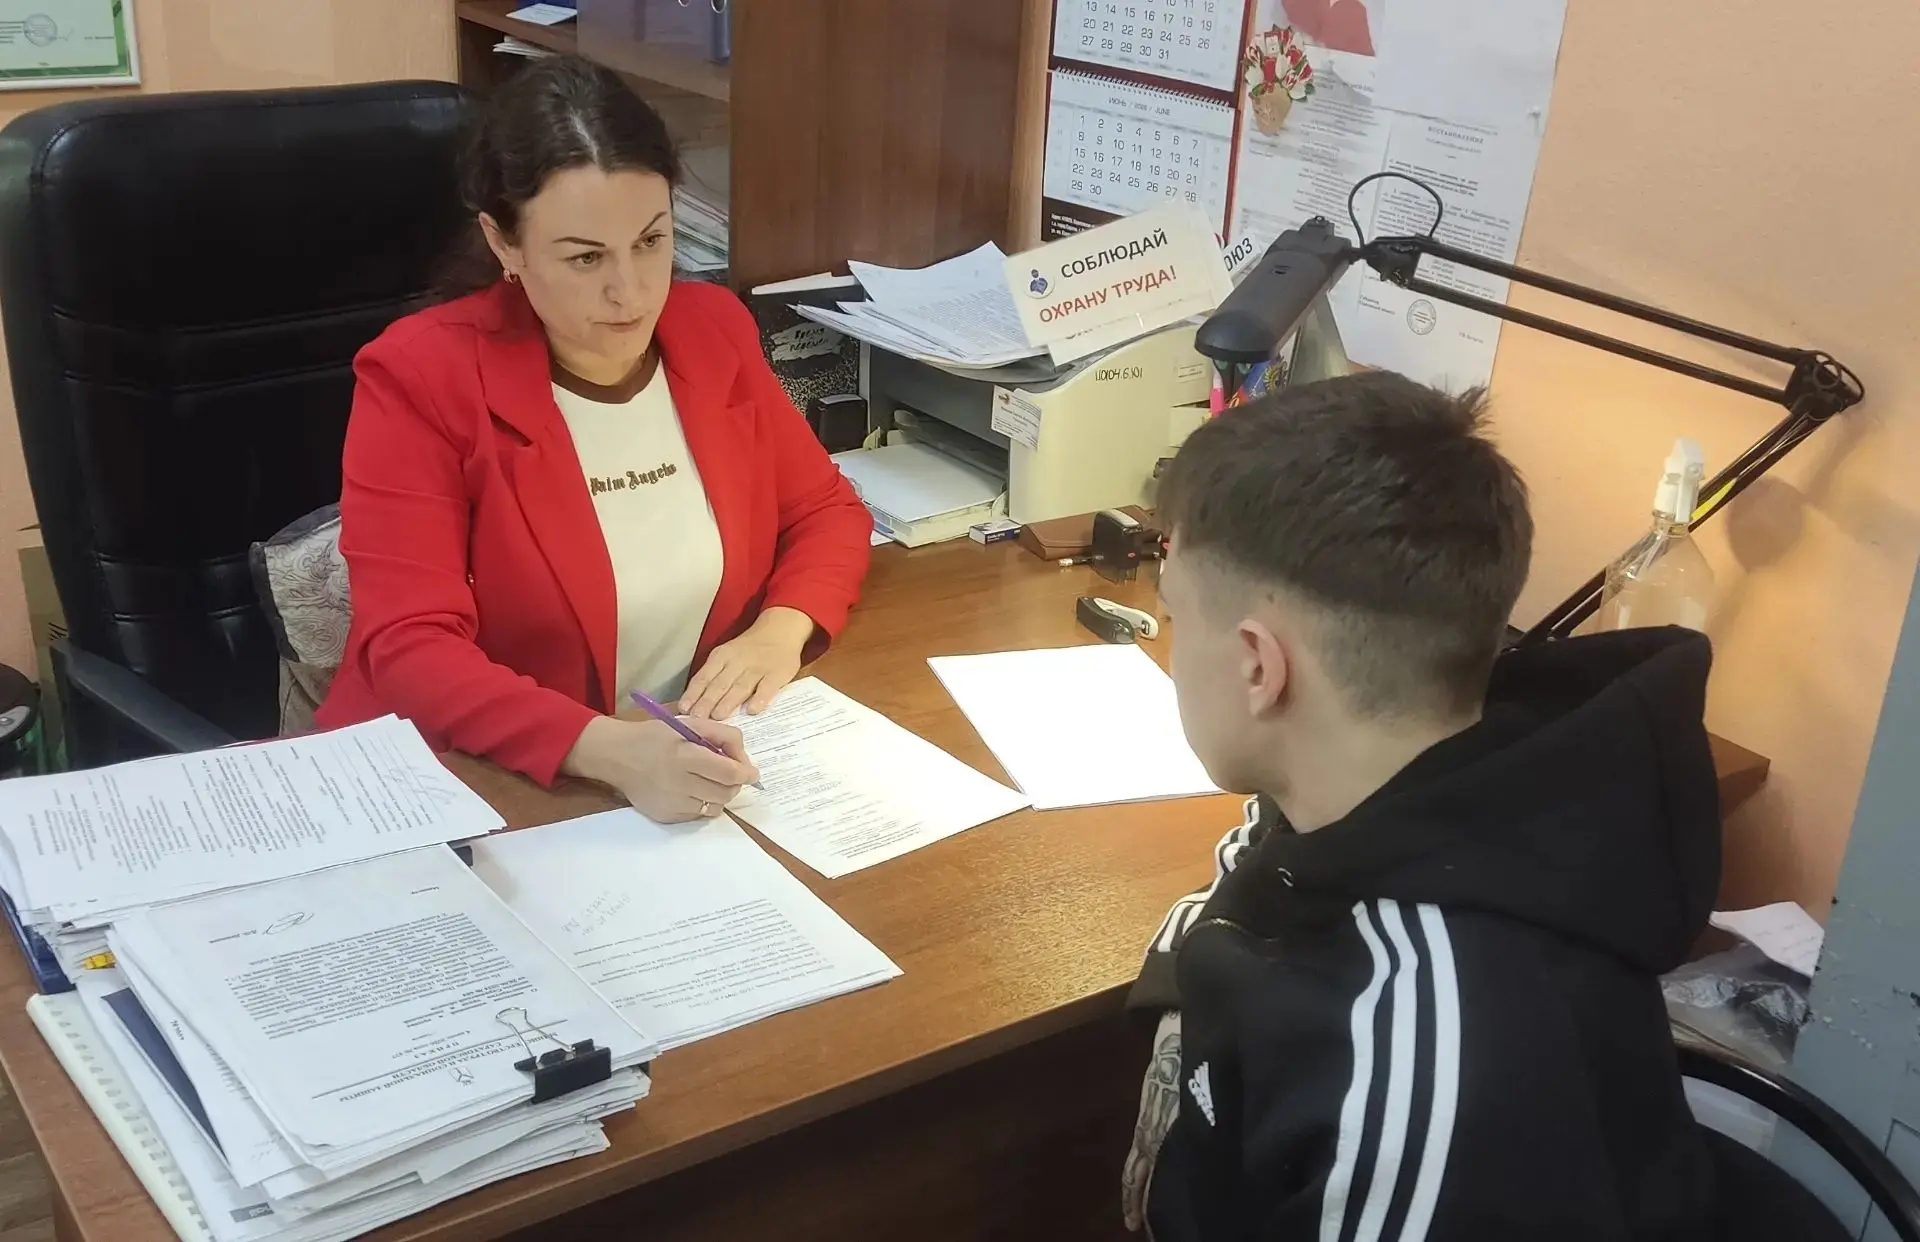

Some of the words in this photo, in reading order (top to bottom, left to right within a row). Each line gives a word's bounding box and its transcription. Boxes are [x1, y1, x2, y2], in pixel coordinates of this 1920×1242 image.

[1086, 1, 1097, 12] 13
[1105, 3, 1116, 15] 14
[1124, 7, 1135, 18] 15
[1144, 10, 1155, 21] 16
[1163, 13, 1174, 24] 17
[1182, 16, 1193, 28] 18
[1202, 19, 1212, 31] 19
[1203, 1, 1214, 13] 12
[1082, 35, 1094, 46] 27
[1101, 39, 1113, 50] 28
[1120, 42, 1132, 53] 29
[1139, 45, 1152, 56] 30
[1158, 49, 1169, 60] 31
[1083, 18, 1096, 29] 20
[1103, 21, 1114, 32] 21
[1121, 25, 1134, 36] 22
[1141, 28, 1153, 39] 23
[1160, 31, 1172, 42] 24
[1179, 35, 1191, 46] 25
[1198, 37, 1210, 50] 26
[1109, 97, 1126, 106] ИЮНЬ
[1155, 108, 1171, 116] JUNE
[1078, 132, 1085, 141] 8
[1097, 136, 1103, 145] 9
[1114, 139, 1124, 150] 10
[1132, 143, 1142, 154] 11
[1151, 148, 1162, 158] 12
[1170, 152, 1181, 163] 13
[1188, 157, 1199, 167] 14
[1080, 116, 1085, 126] 1
[1098, 119, 1104, 128] 2
[1116, 123, 1123, 133] 3
[1135, 128, 1142, 137] 4
[1155, 131, 1161, 141] 5
[1173, 135, 1179, 145] 6
[1192, 140, 1198, 150] 7
[1072, 164, 1084, 174] 22
[1091, 168, 1102, 179] 23
[1109, 172, 1121, 183] 24
[1128, 177, 1140, 189] 25
[1147, 182, 1159, 193] 26
[1165, 186, 1177, 197] 27
[1184, 191, 1196, 202] 28
[1075, 147, 1086, 158] 15
[1093, 152, 1104, 163] 16
[1111, 156, 1122, 167] 17
[1131, 160, 1142, 171] 18
[1149, 165, 1160, 175] 19
[1167, 169, 1179, 181] 20
[1186, 174, 1197, 185] 21
[1072, 180, 1083, 191] 29
[1089, 184, 1101, 195] 30
[1061, 227, 1169, 278] СОБЛЮДАЙ
[1039, 288, 1108, 323] ОХРАНУ
[1112, 265, 1177, 299] ТРУДА!
[589, 476, 626, 496] Palm
[626, 462, 677, 490] Angels
